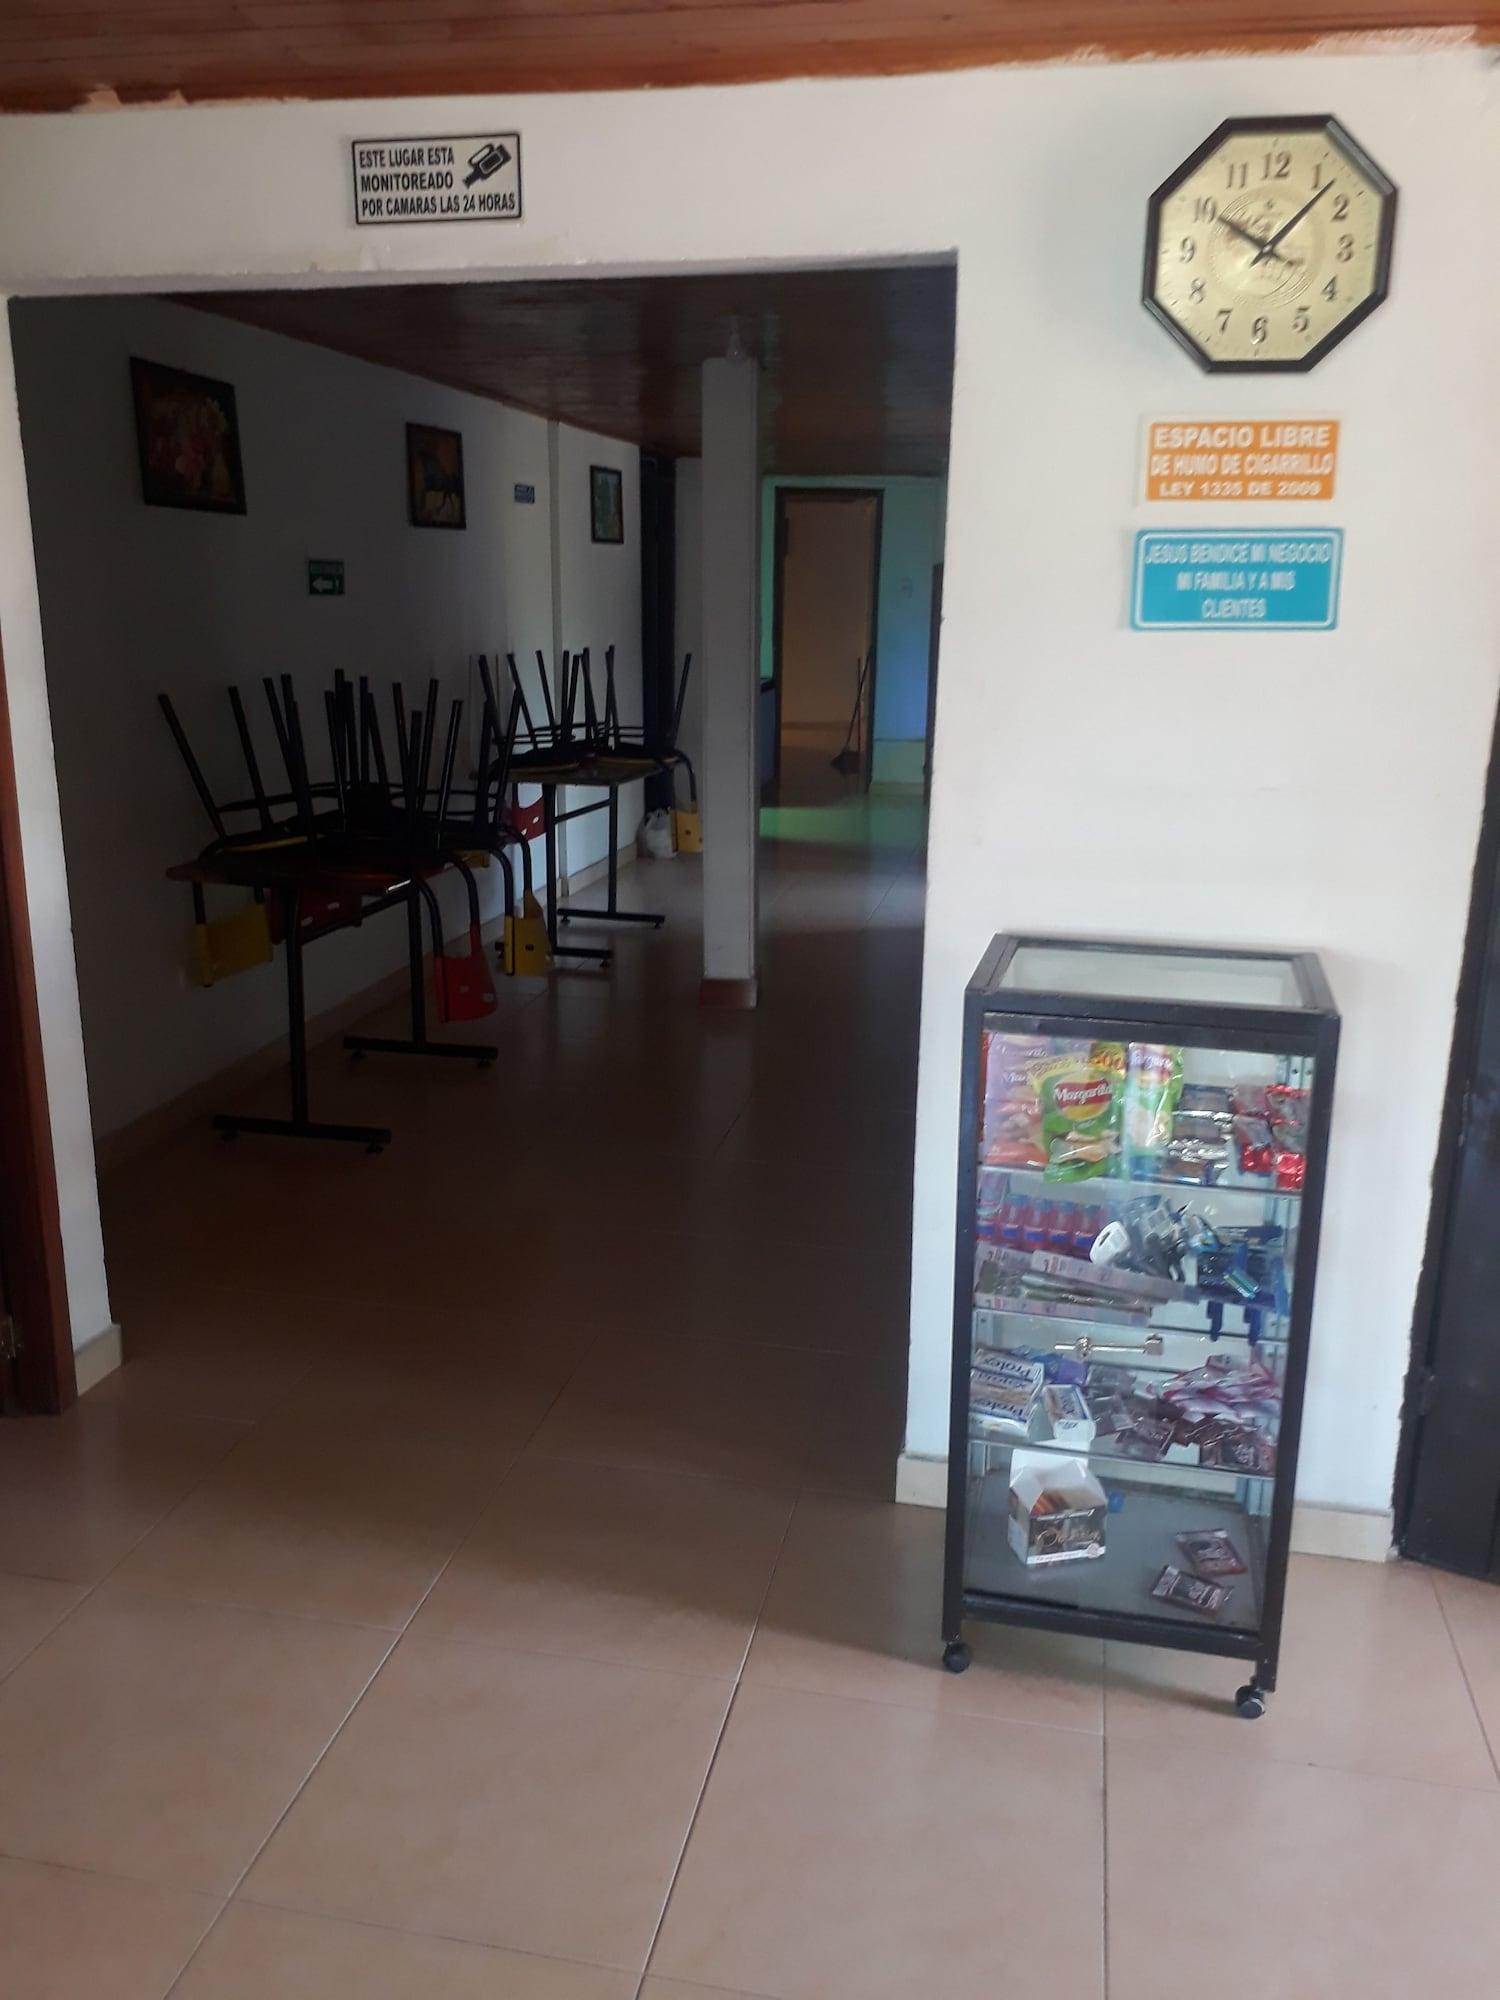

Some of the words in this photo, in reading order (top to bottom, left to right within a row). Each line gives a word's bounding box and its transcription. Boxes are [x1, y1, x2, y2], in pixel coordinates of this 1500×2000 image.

[359, 150, 386, 168] ESTE
[389, 147, 425, 167] LUGAR
[428, 147, 455, 166] ESTA
[1261, 151, 1292, 180] 12
[361, 171, 454, 192] MONITOREADO
[1225, 162, 1249, 190] 11
[1311, 163, 1323, 190] 1
[362, 197, 383, 217] POR
[386, 195, 437, 215] CAMARAS
[440, 194, 460, 213] LAS
[463, 193, 476, 212] 24
[479, 192, 516, 212] HORAS
[1192, 196, 1218, 224] 10
[1331, 193, 1350, 222] 2
[1179, 236, 1197, 264] 9
[1336, 233, 1355, 262] 3
[1189, 277, 1206, 304] 8
[1320, 274, 1339, 302] 4
[1217, 308, 1234, 334] 7
[1251, 316, 1269, 345] 6
[1292, 306, 1312, 334] 5
[1154, 425, 1254, 448] ESPACIO
[1259, 424, 1331, 448] LIBRE
[1151, 454, 1171, 476] DE
[1173, 453, 1218, 476] HUMO
[1220, 454, 1241, 476] DE
[1244, 453, 1334, 475] CIGARRILLO
[1159, 482, 1195, 496] LEY
[1199, 482, 1243, 496] 1335
[1247, 482, 1272, 496] DE
[1276, 481, 1321, 496] 2009
[1145, 544, 1188, 564] JESUS
[1190, 543, 1250, 563] BENDICE
[1251, 543, 1266, 563] MI
[1176, 572, 1192, 591] MI
[1194, 571, 1244, 590] FAMILIA
[1246, 571, 1258, 590] Y
[1256, 571, 1267, 590] A
[1270, 571, 1296, 591] MIS
[1201, 598, 1267, 619] CLIENTES
[1053, 1079, 1114, 1105] Margarita
